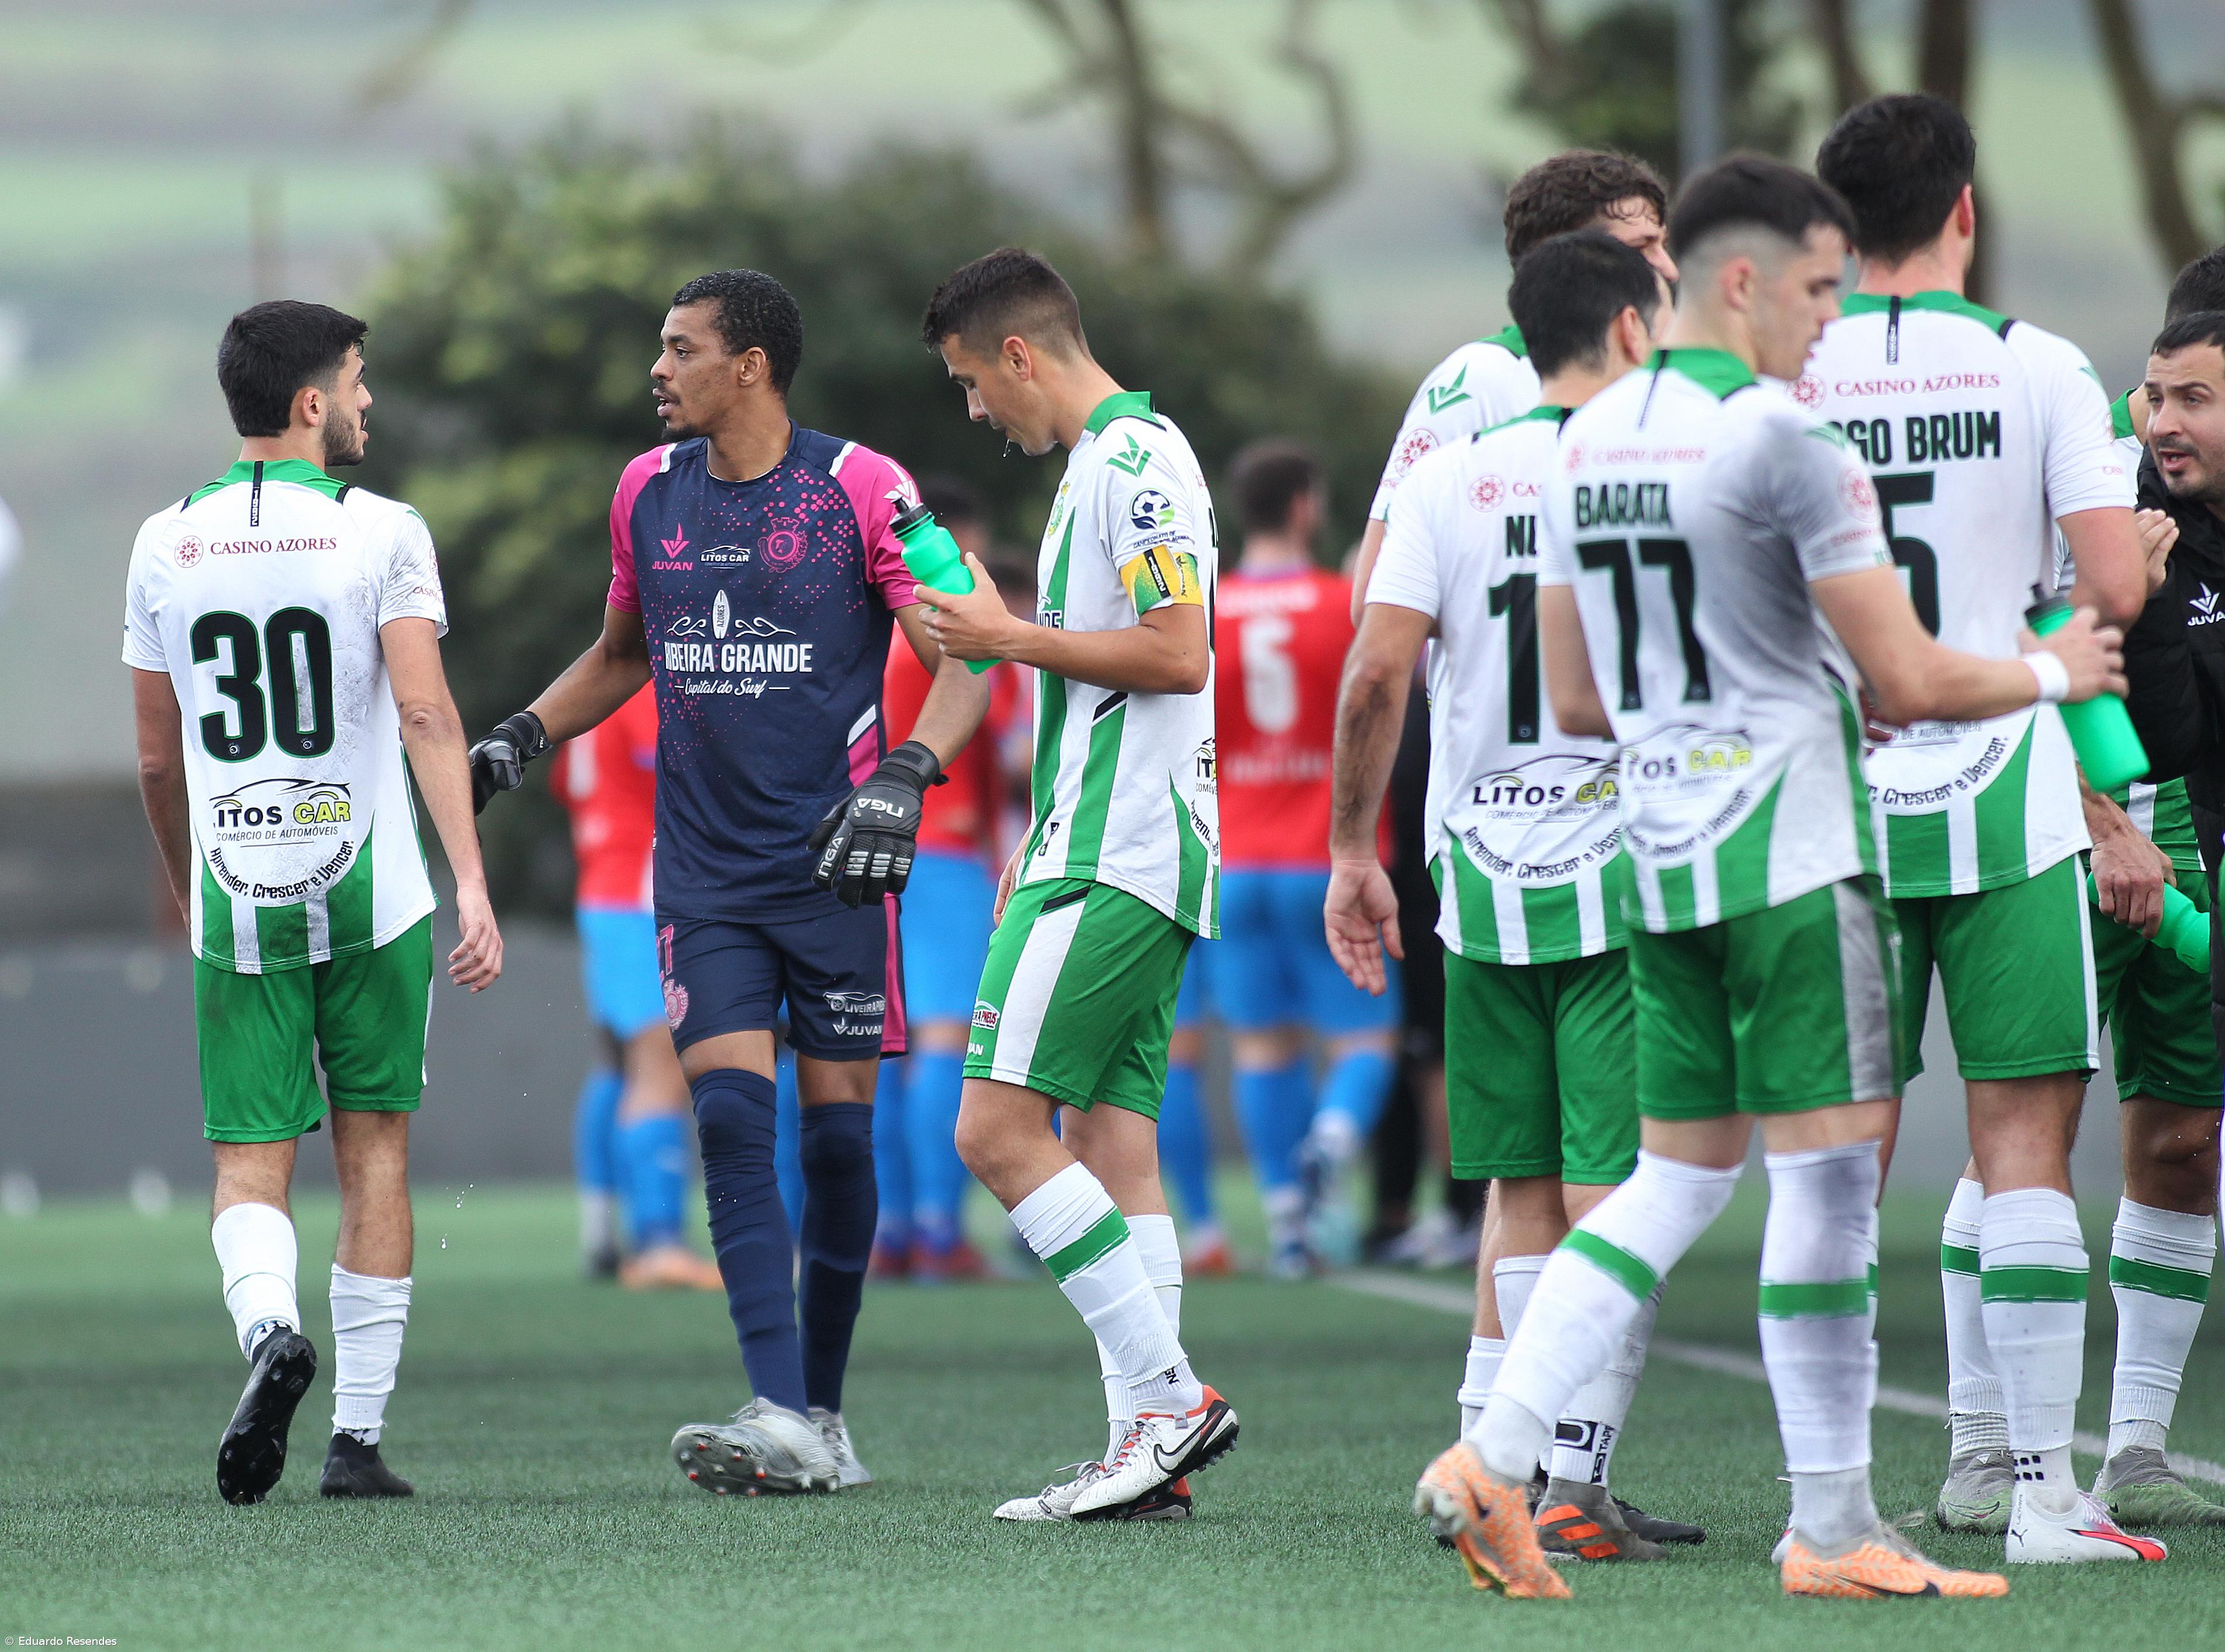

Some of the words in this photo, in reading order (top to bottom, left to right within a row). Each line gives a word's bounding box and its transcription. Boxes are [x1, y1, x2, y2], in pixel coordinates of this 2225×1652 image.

[1836, 380, 1916, 397] CASINO
[1923, 374, 2000, 393] AZORES
[1906, 411, 2001, 463] BRUM
[1575, 483, 1672, 529] BARATA
[211, 541, 272, 555] CASINO
[276, 538, 337, 552] AZORES
[701, 554, 728, 562] LITOS
[729, 553, 750, 562] CAR
[652, 561, 693, 571] JUVAN
[1148, 556, 1166, 592] 1992
[716, 604, 725, 628] AZORES
[1573, 538, 1711, 711] 77
[664, 642, 715, 672] RIBEIRA
[721, 643, 813, 673] GRANDE
[190, 606, 335, 763] 30
[685, 677, 718, 696] Capital
[717, 680, 732, 694] do
[734, 677, 767, 699] Surf
[1473, 787, 1565, 806] LITOS
[1883, 783, 1953, 806] Crescer
[1955, 779, 1968, 790] e
[213, 806, 283, 828] ITOS
[293, 801, 351, 824] CAR
[216, 830, 261, 842] COMÉRCIO
[265, 830, 276, 839] DE
[280, 825, 338, 838] AUTOMÓVEIS
[210, 846, 249, 897] Aprender,
[252, 879, 309, 899] Crescer
[311, 876, 322, 887] e
[1517, 856, 1580, 879] Crescer
[1582, 853, 1595, 863] e
